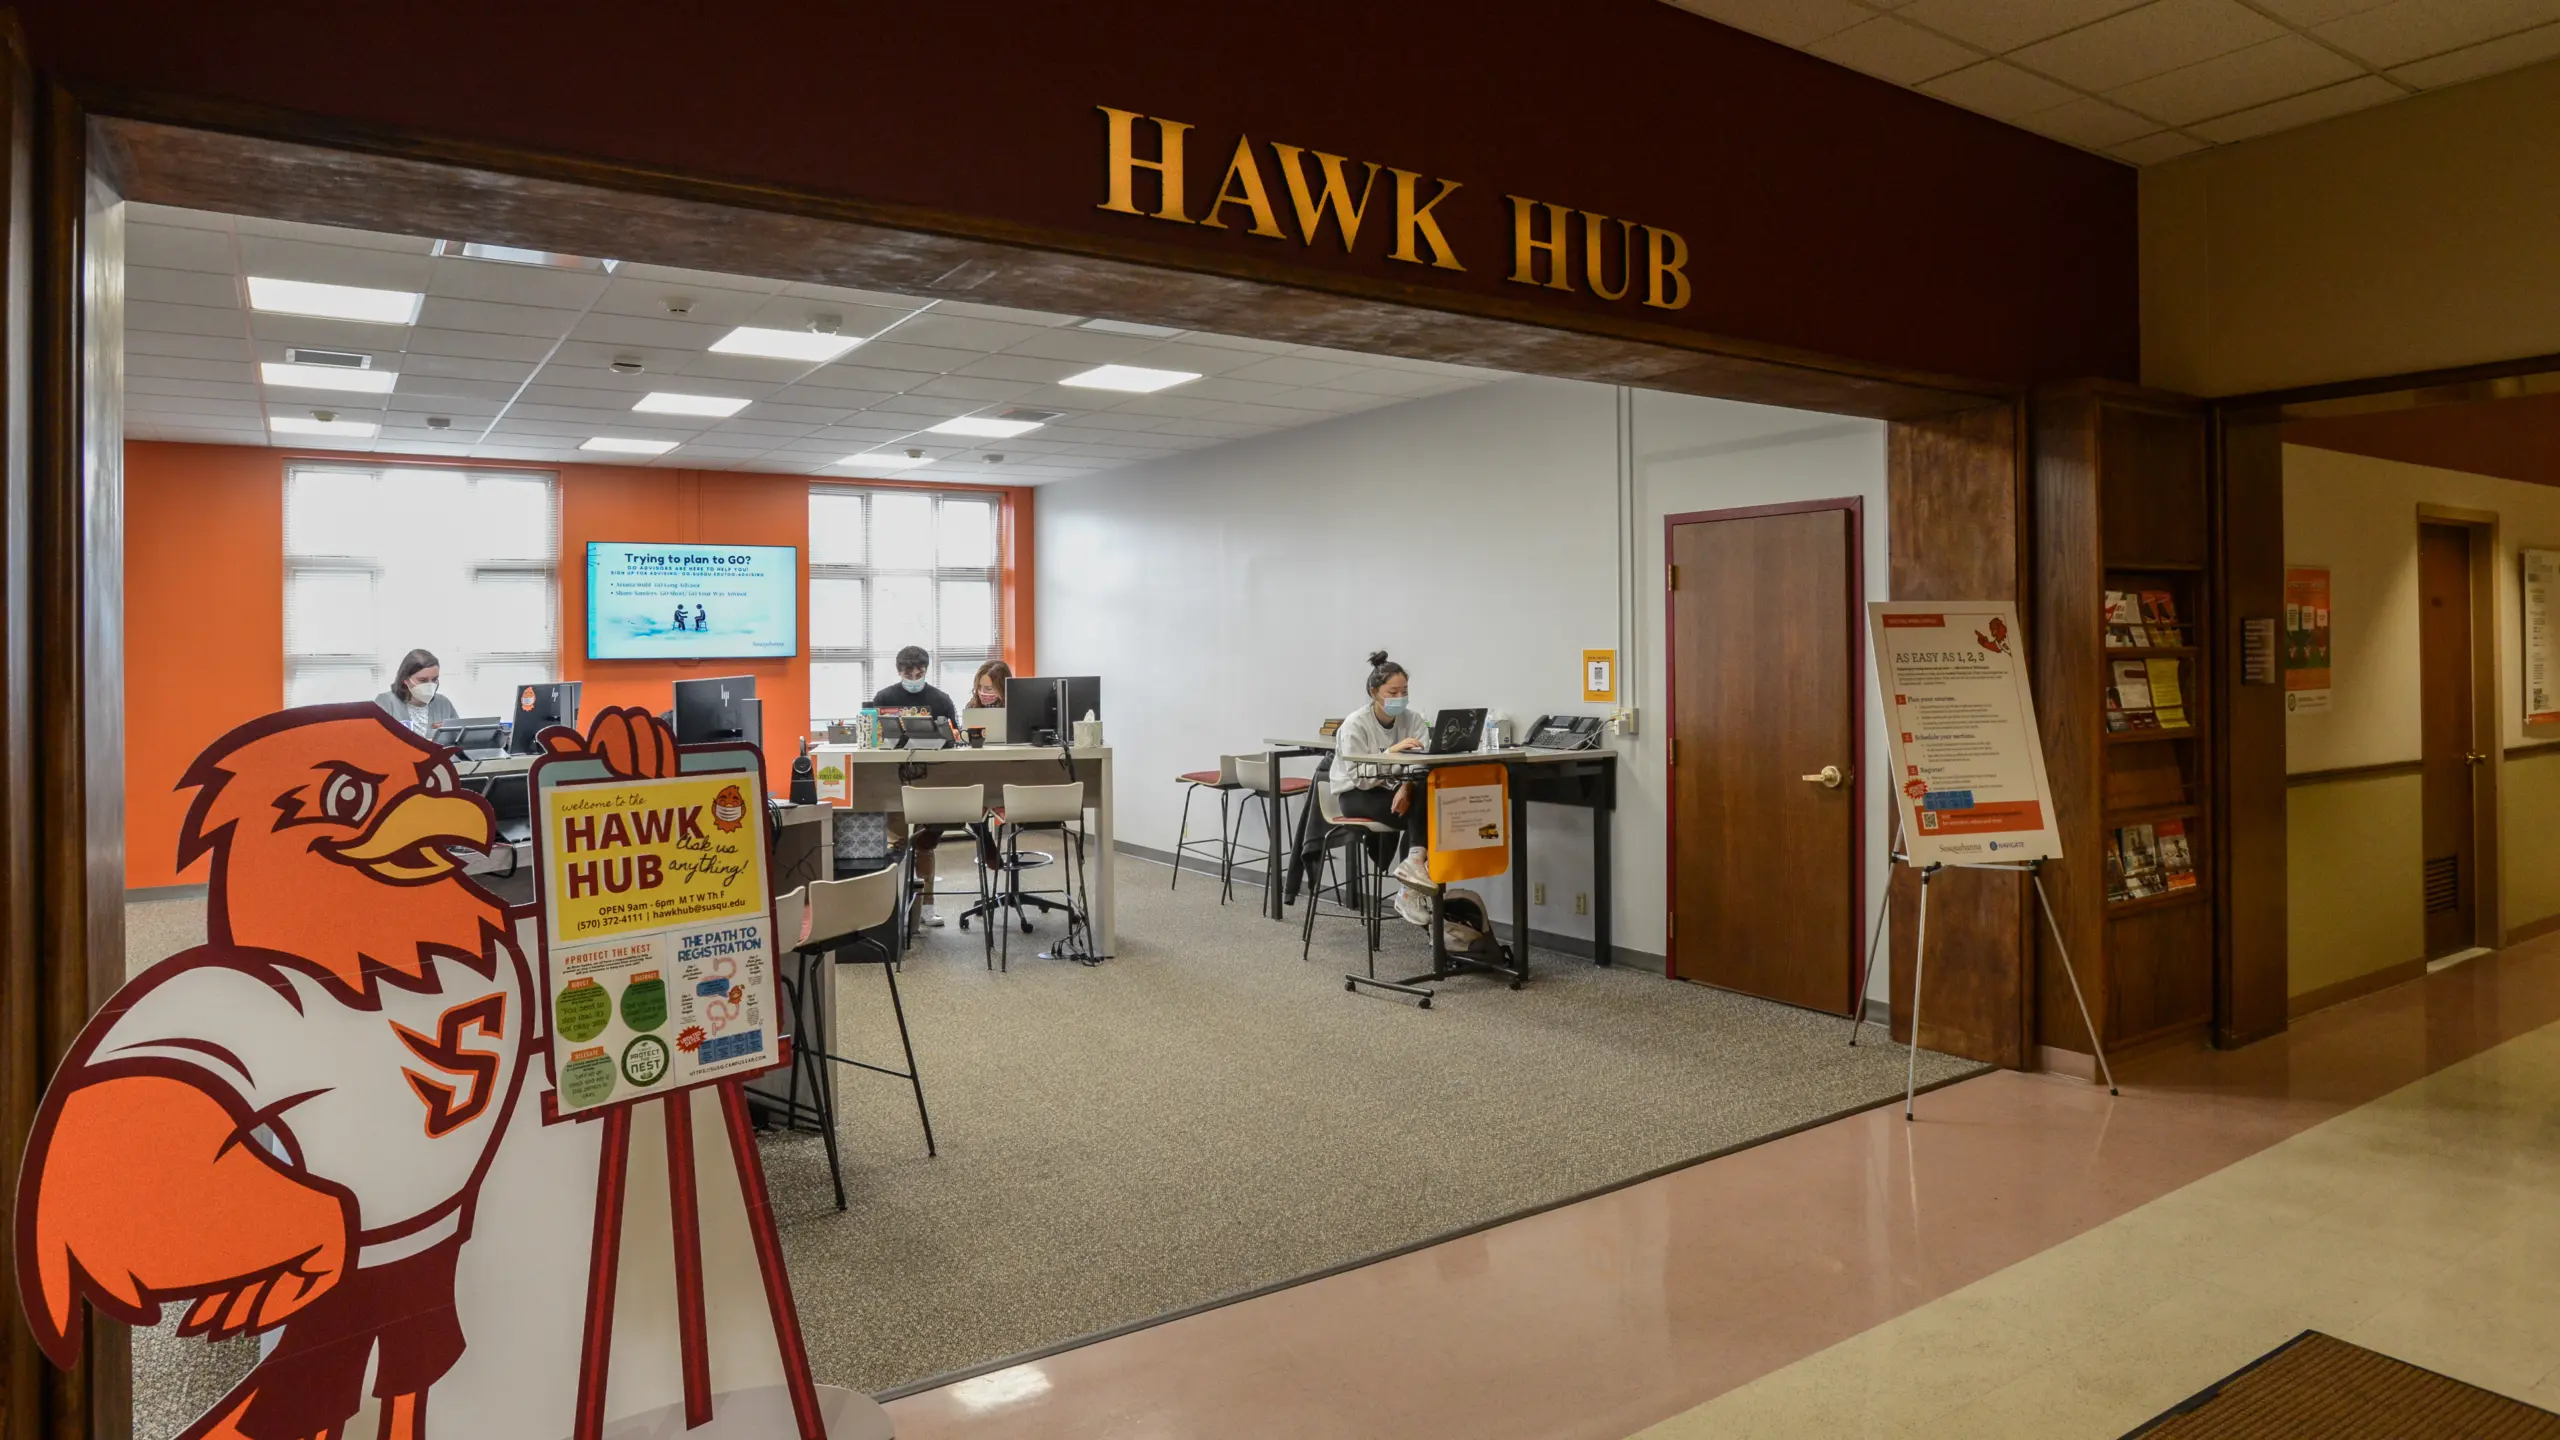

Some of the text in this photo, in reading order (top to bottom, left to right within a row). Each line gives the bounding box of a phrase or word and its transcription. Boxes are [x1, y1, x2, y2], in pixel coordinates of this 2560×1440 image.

[1096, 104, 1692, 311] HAWK HUB
[624, 553, 751, 566] Trying to plan to GO?
[1896, 652, 1984, 663] AS EASY AS 1, 2, 3
[562, 793, 647, 812] welcome to the
[564, 805, 705, 853] HAWK
[716, 844, 739, 854] us
[1939, 842, 1982, 854] Susquehanna
[567, 854, 664, 899] HUB
[668, 854, 749, 887] anything!
[599, 905, 625, 916] OPEN
[628, 902, 648, 912] 9am
[655, 898, 675, 909] 6pm
[679, 896, 687, 904] M
[689, 895, 694, 903] T
[694, 893, 706, 902] W
[707, 891, 718, 901] Th
[720, 890, 725, 899] F
[577, 919, 601, 932] (570)
[602, 914, 643, 927] 372-4111
[652, 899, 746, 919] hawkhub@susqu.edu
[682, 926, 757, 948] THE PATH TO
[564, 943, 651, 965] #PROTECT THE NEST
[678, 938, 762, 962] REGISTRATION
[630, 1048, 660, 1060] PROTECT
[630, 1060, 661, 1074] NEST
